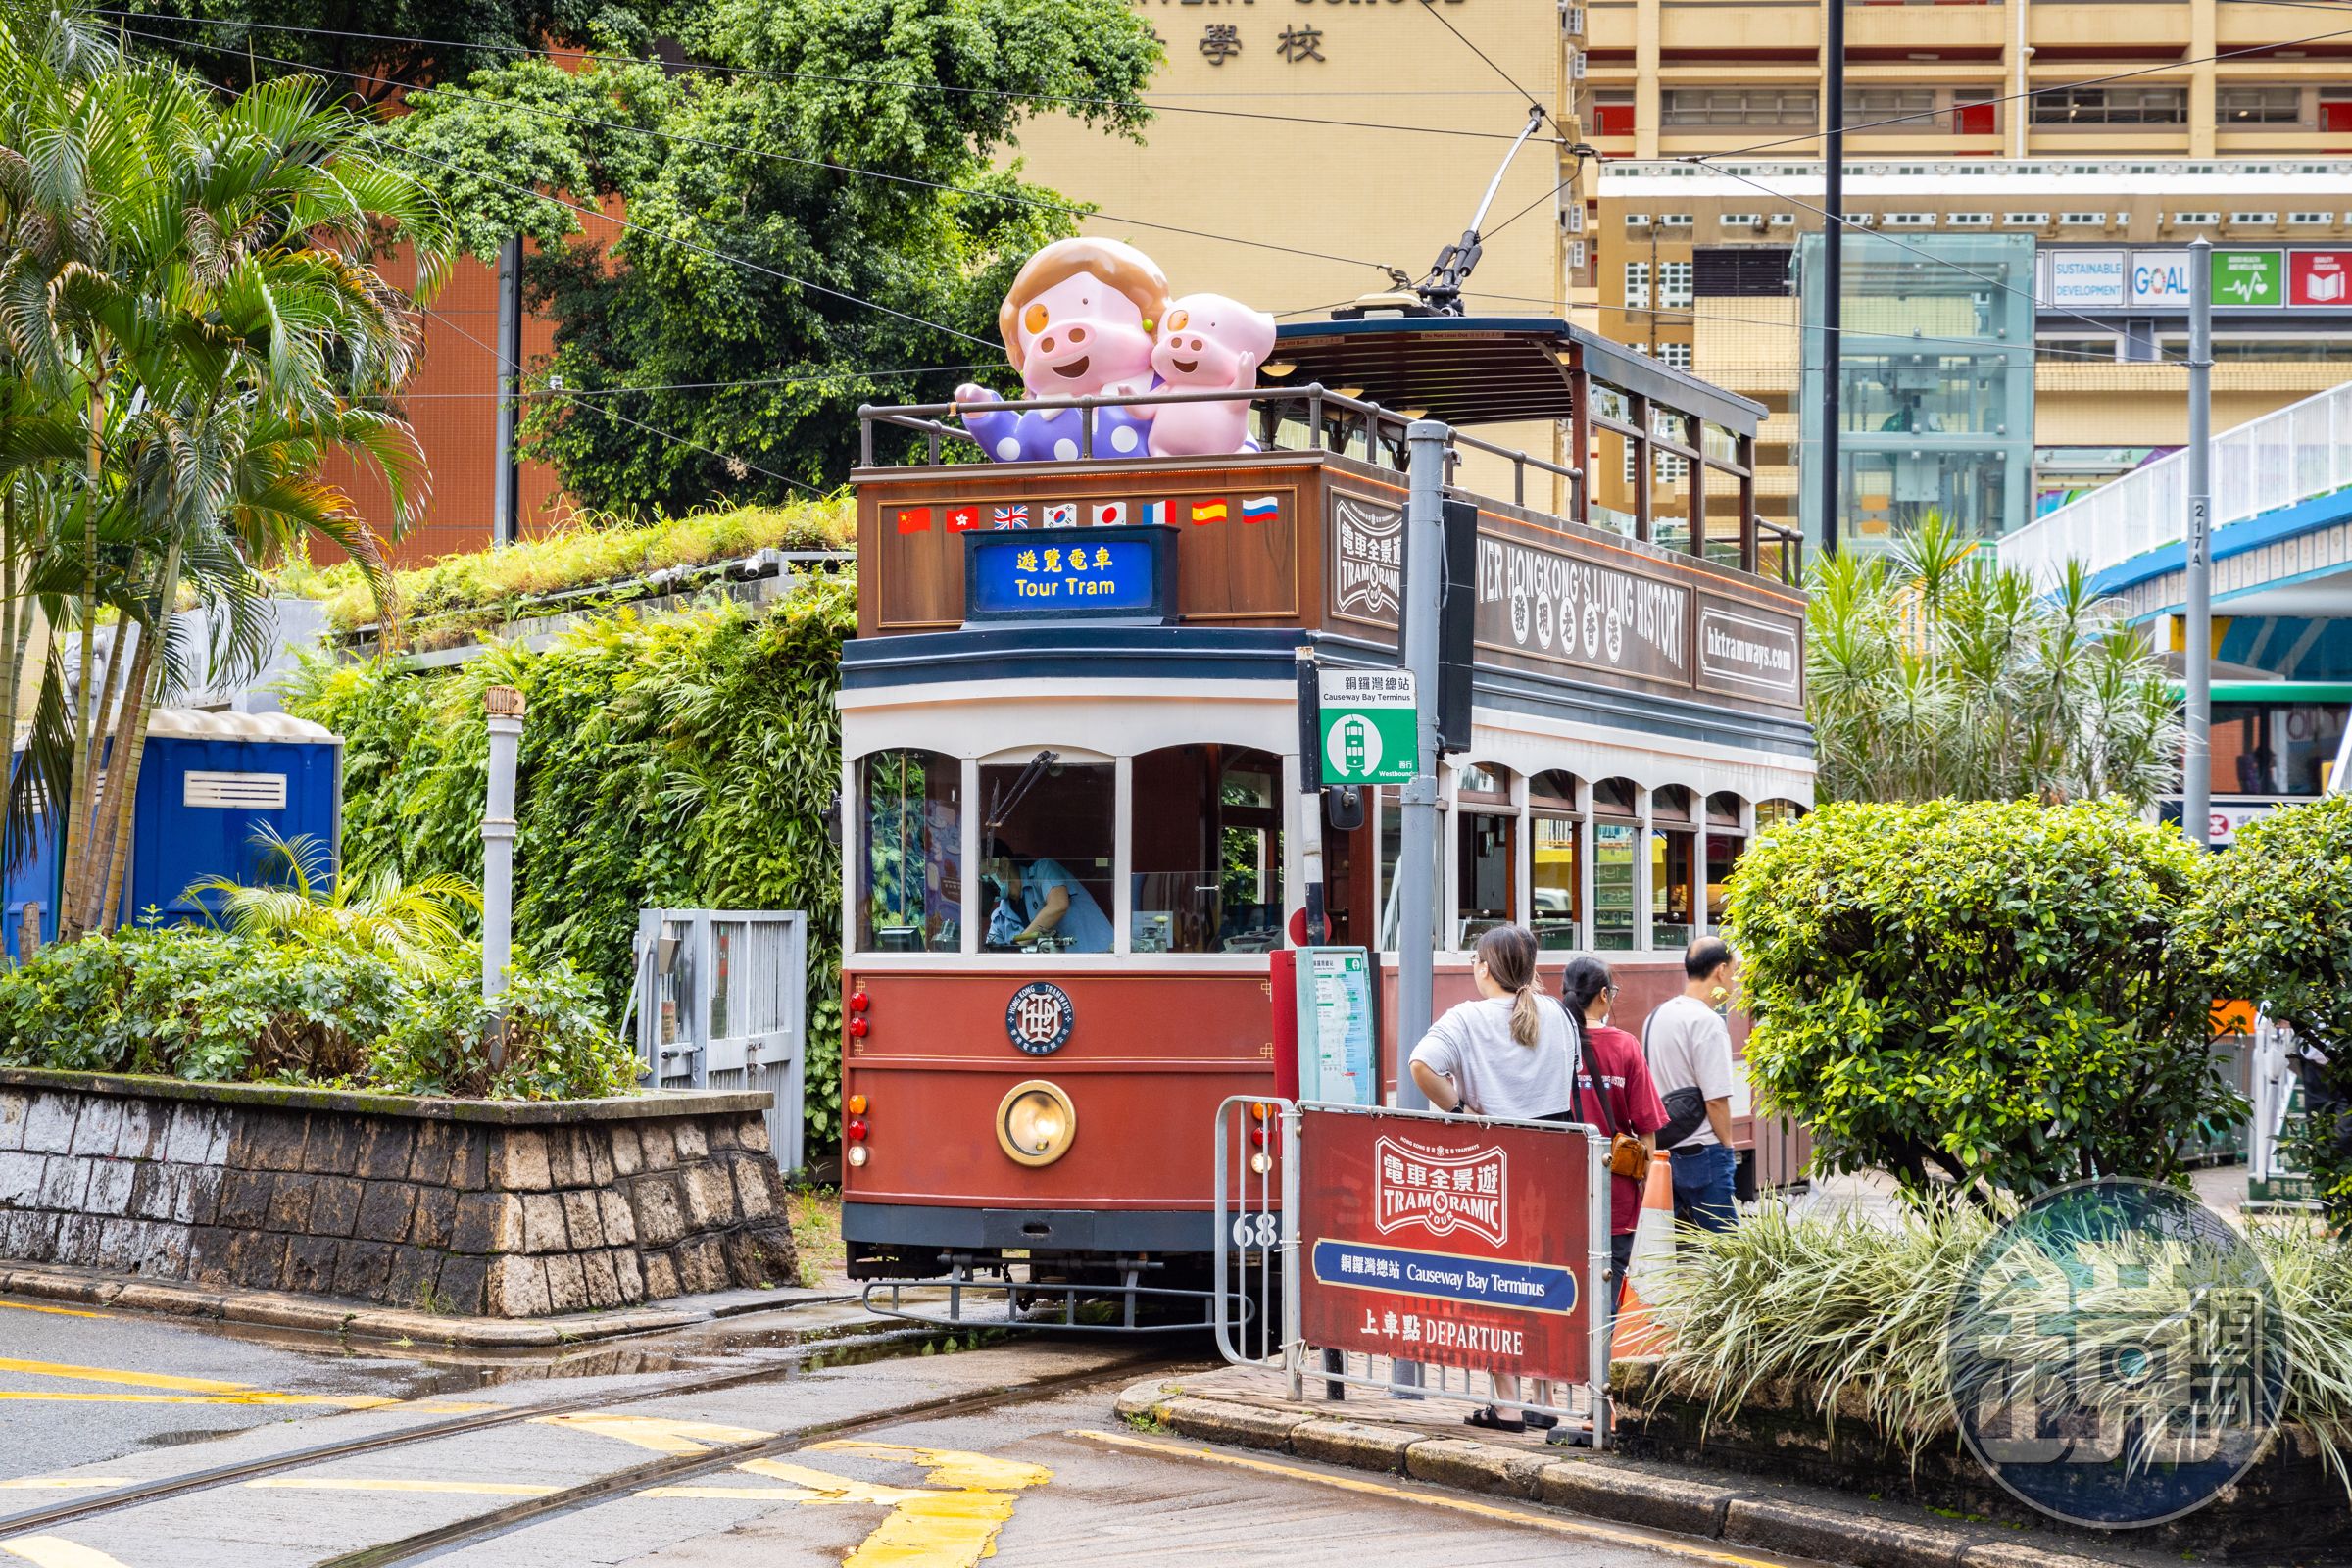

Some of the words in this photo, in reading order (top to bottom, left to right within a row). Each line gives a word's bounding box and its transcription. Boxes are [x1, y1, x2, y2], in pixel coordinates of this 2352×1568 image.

[1143, 24, 1326, 66] 學校
[2055, 262, 2122, 275] SUSTAINABLE
[2055, 285, 2122, 297] DEVELOPMENT
[2192, 504, 2204, 566] 217A
[1016, 546, 1114, 573] 遊覽電車
[1014, 579, 1059, 597] Tour
[1065, 578, 1115, 595] Tram
[1341, 560, 1400, 598] TRAMORAMI
[1476, 538, 1504, 604] VER
[1593, 568, 1634, 628] LIVING
[1636, 579, 1684, 669] HISTORY
[1707, 626, 1791, 671] hktramways.com
[1323, 693, 1360, 702] Causeway
[1361, 693, 1376, 702] Bay
[1378, 693, 1411, 702] Terminus
[1345, 676, 1410, 691] 銅鑼灣總站
[1008, 996, 1021, 1015] HONG
[1018, 984, 1036, 1000] KONG
[1044, 984, 1072, 1015] TRAMWAYS
[1383, 1153, 1498, 1195] 電車全景遊
[1383, 1189, 1499, 1231] TRAMORAMIC
[1428, 1208, 1454, 1225] TOUR
[1232, 1213, 1277, 1248] 68
[1340, 1253, 1400, 1280] 銅鑼灣總站
[1406, 1263, 1464, 1291] Causeway
[1466, 1270, 1489, 1294] Bay
[1491, 1273, 1545, 1297] Terminus
[1359, 1308, 1421, 1342] 上車點
[1425, 1318, 1524, 1356] DEPARTURE
